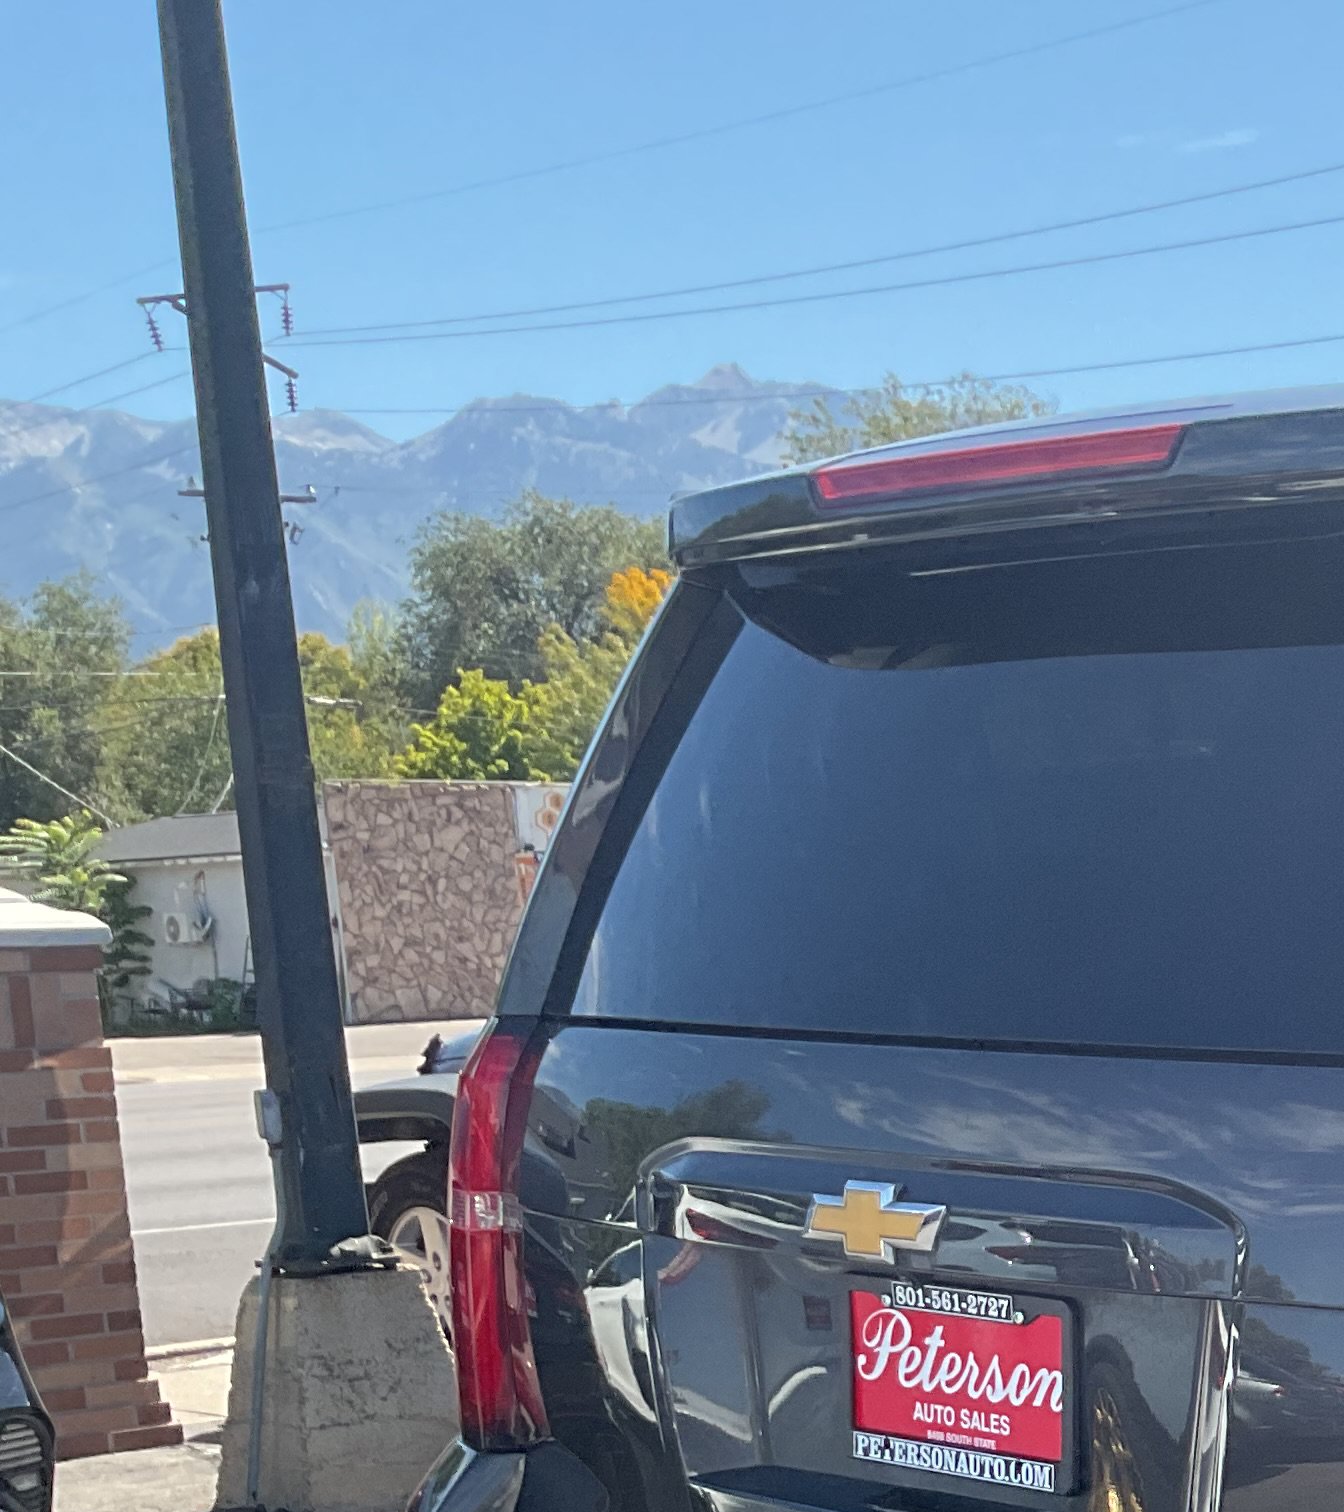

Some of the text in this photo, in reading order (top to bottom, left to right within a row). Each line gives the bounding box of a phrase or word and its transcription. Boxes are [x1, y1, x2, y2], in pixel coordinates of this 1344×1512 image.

[895, 1285, 1009, 1319] 801-561-2727
[857, 1308, 1063, 1413] Peterson
[912, 1401, 955, 1427] AUTO
[960, 1408, 1011, 1436] SALES
[856, 1434, 1051, 1489] PETERSONAUTO.COM
